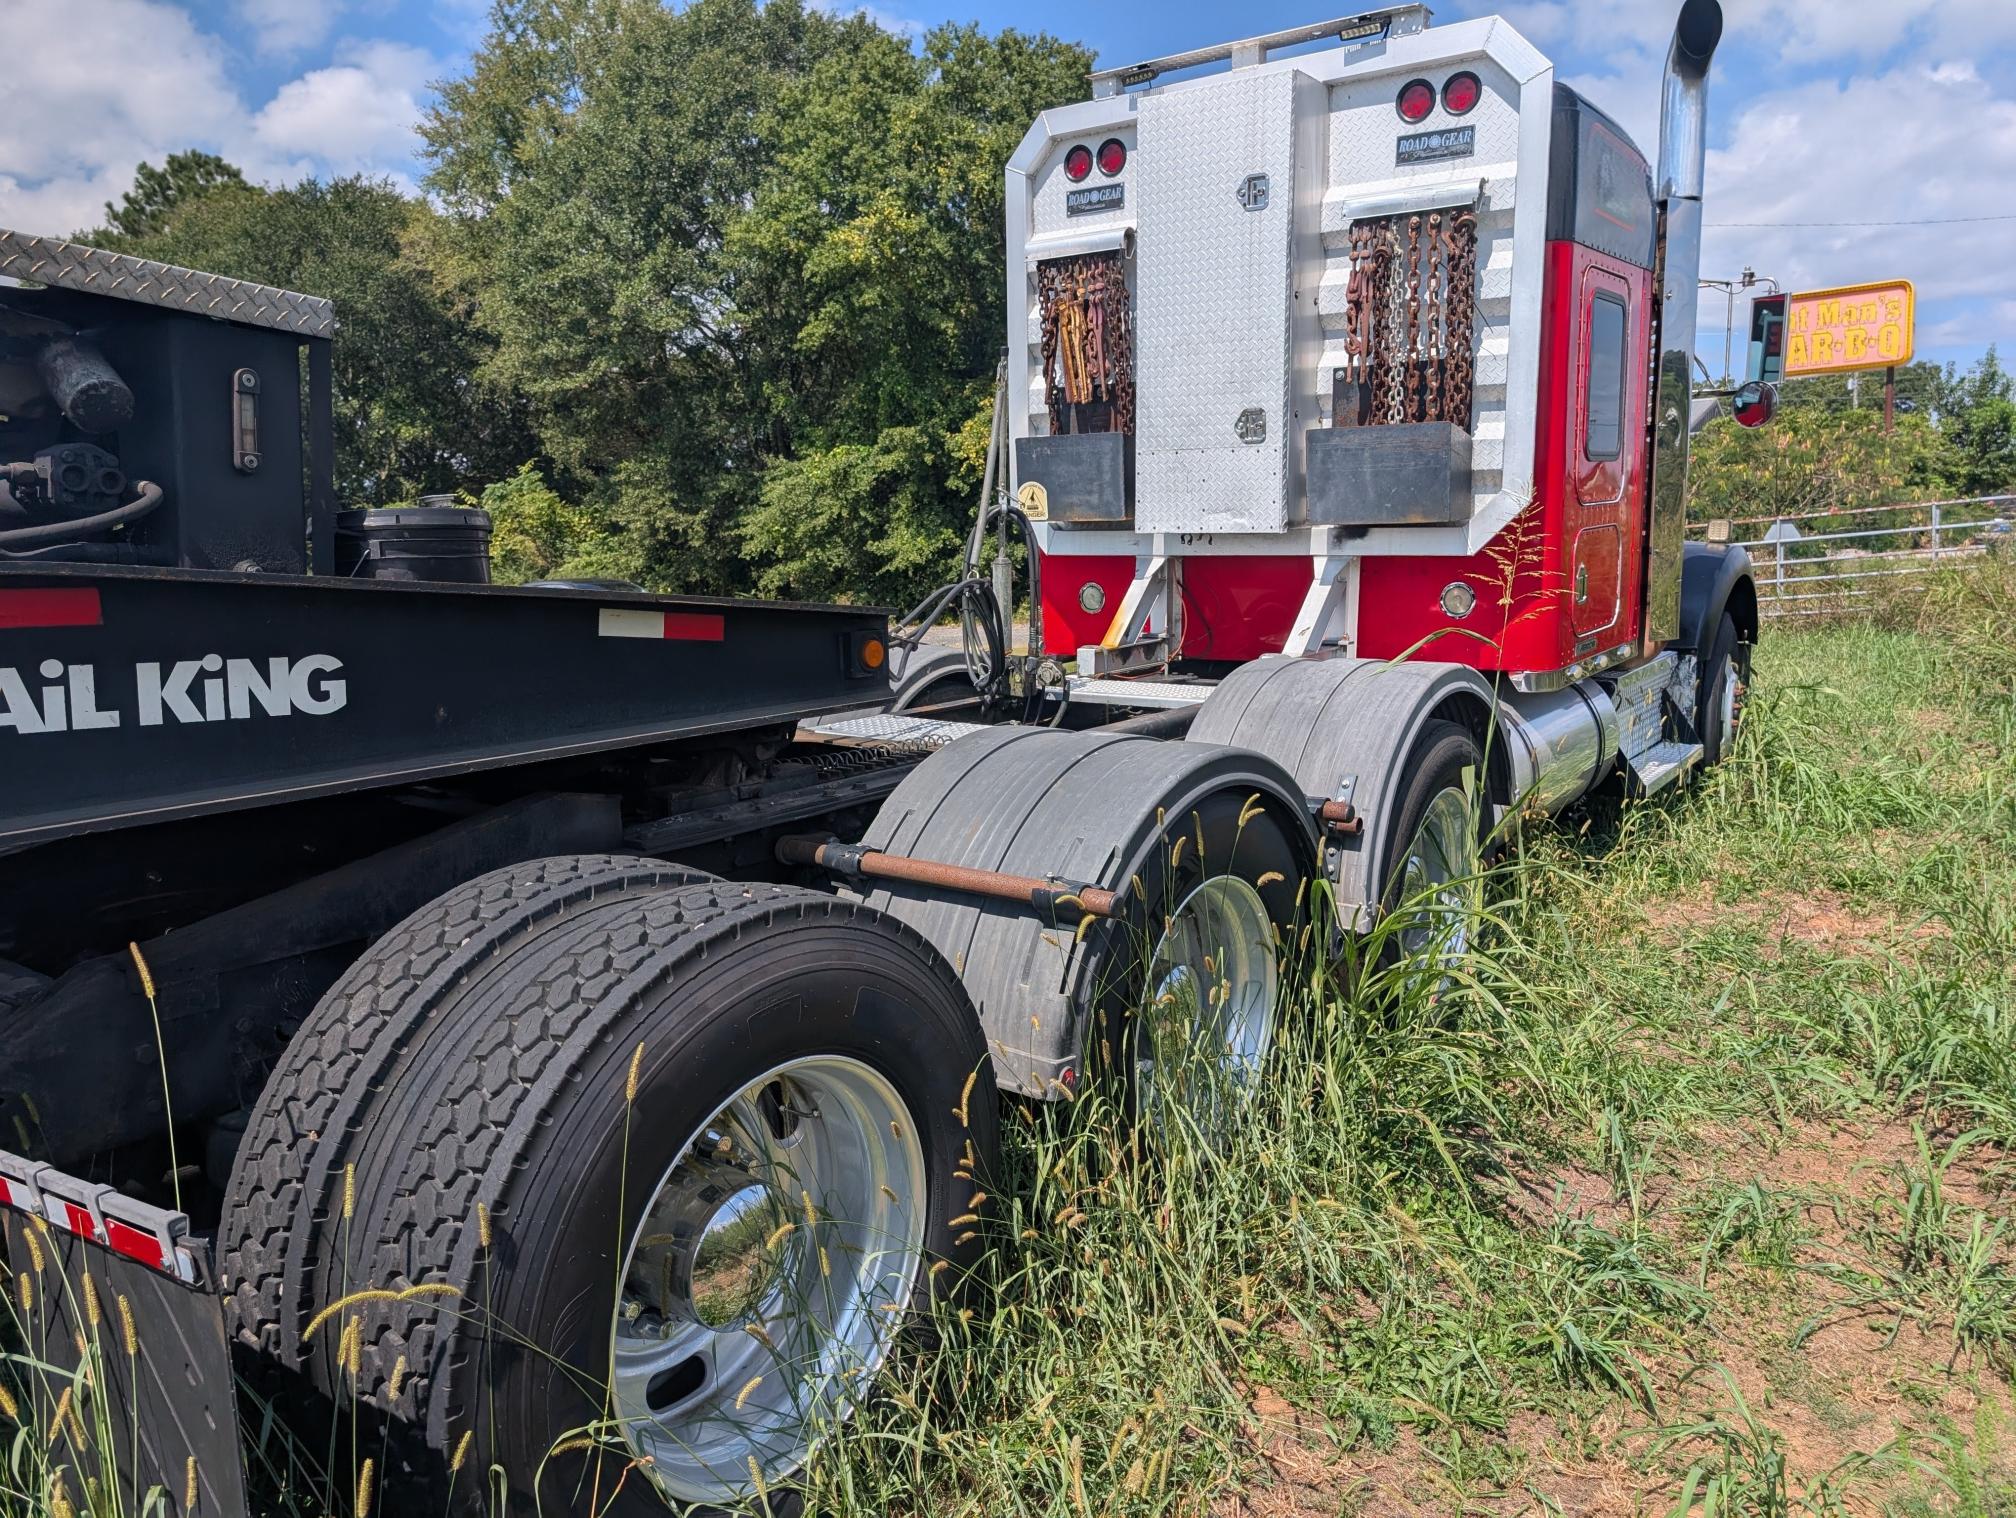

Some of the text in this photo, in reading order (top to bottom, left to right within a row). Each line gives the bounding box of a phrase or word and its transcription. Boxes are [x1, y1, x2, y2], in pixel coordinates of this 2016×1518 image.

[1399, 136, 1428, 153] ROAD
[1441, 130, 1472, 147] GEAR
[1068, 192, 1090, 207] ROAD
[1099, 187, 1122, 201] GEAR
[1817, 295, 1901, 329] Man's
